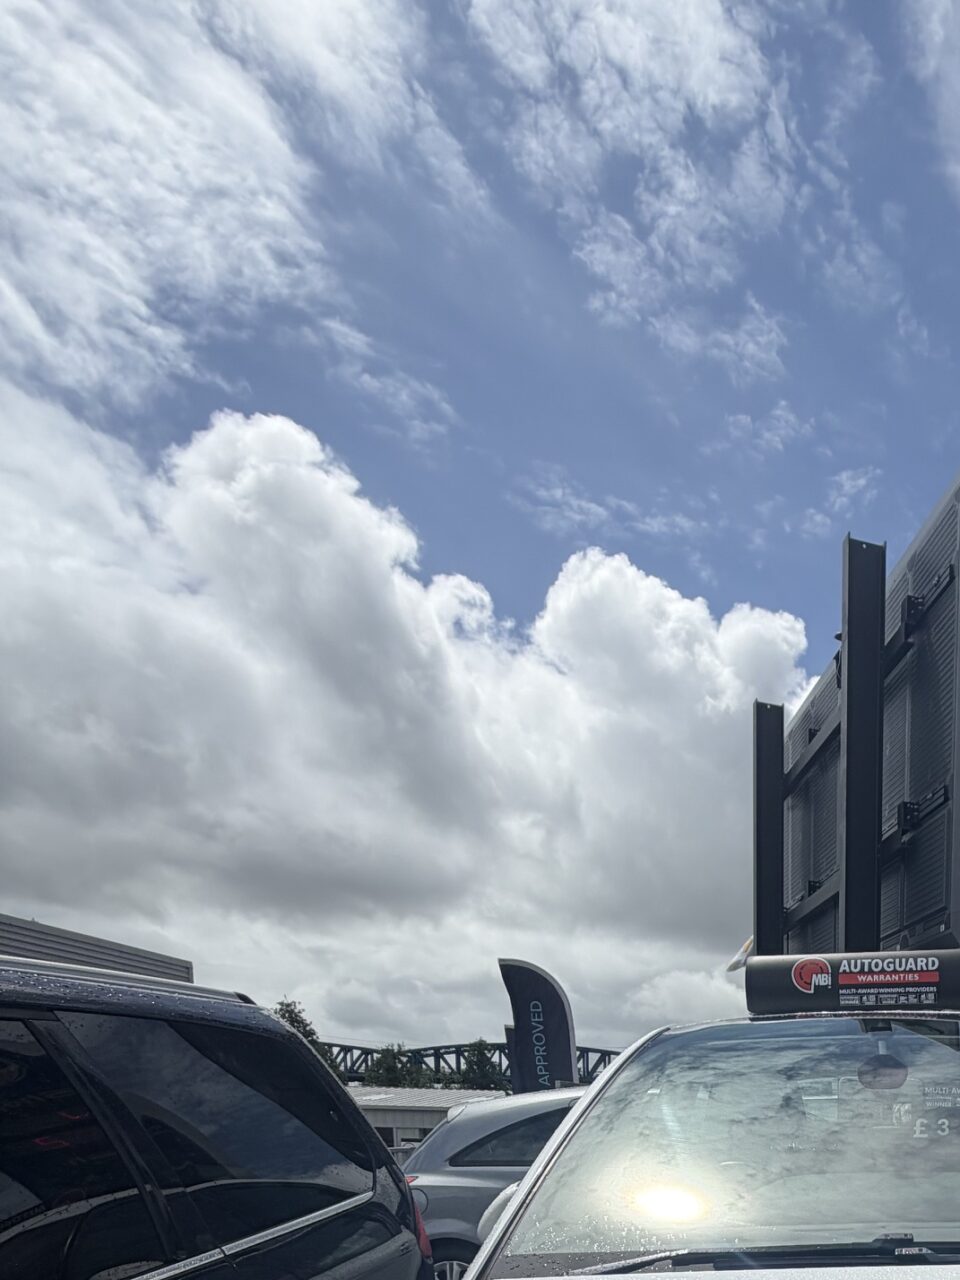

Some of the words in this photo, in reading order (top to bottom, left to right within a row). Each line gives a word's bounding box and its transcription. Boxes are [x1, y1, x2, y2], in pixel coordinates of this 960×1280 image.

[839, 957, 939, 973] AUTOGUARD
[857, 973, 919, 983] WARRANTIES
[530, 1000, 551, 1086] APPROVED
